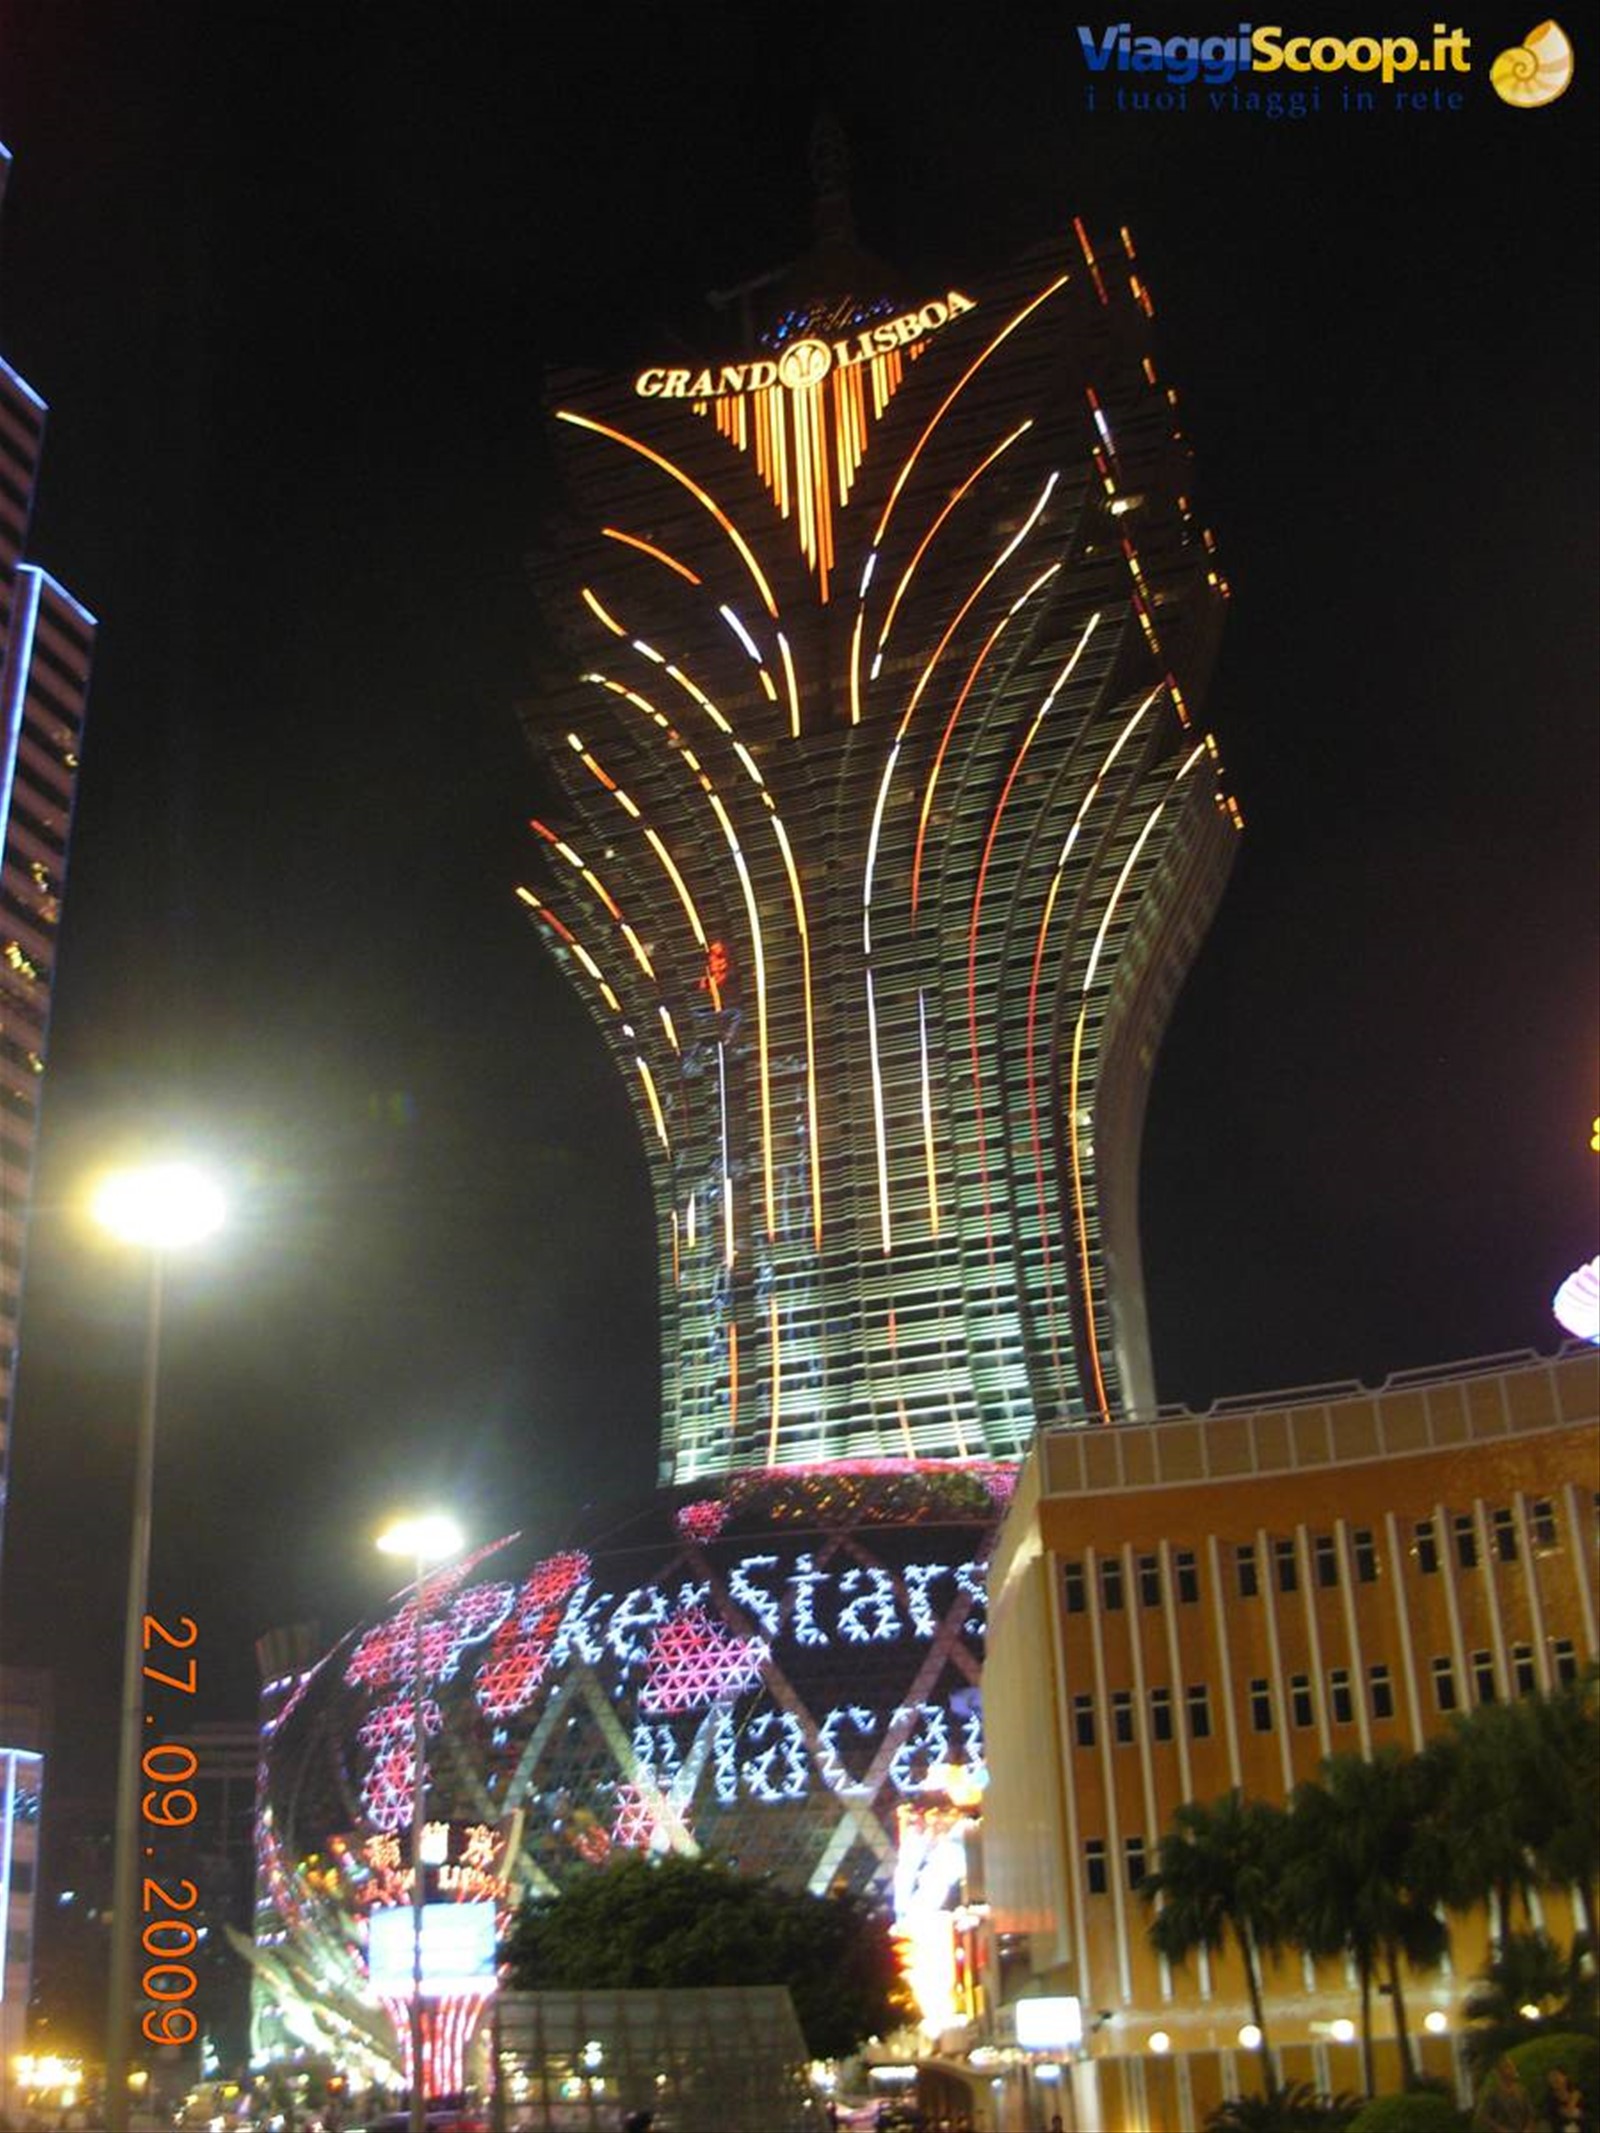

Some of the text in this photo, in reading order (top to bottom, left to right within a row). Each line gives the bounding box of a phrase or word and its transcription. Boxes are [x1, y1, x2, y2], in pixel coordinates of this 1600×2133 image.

[635, 290, 976, 398] GRAND LISBOA
[437, 1578, 712, 1684] Pke
